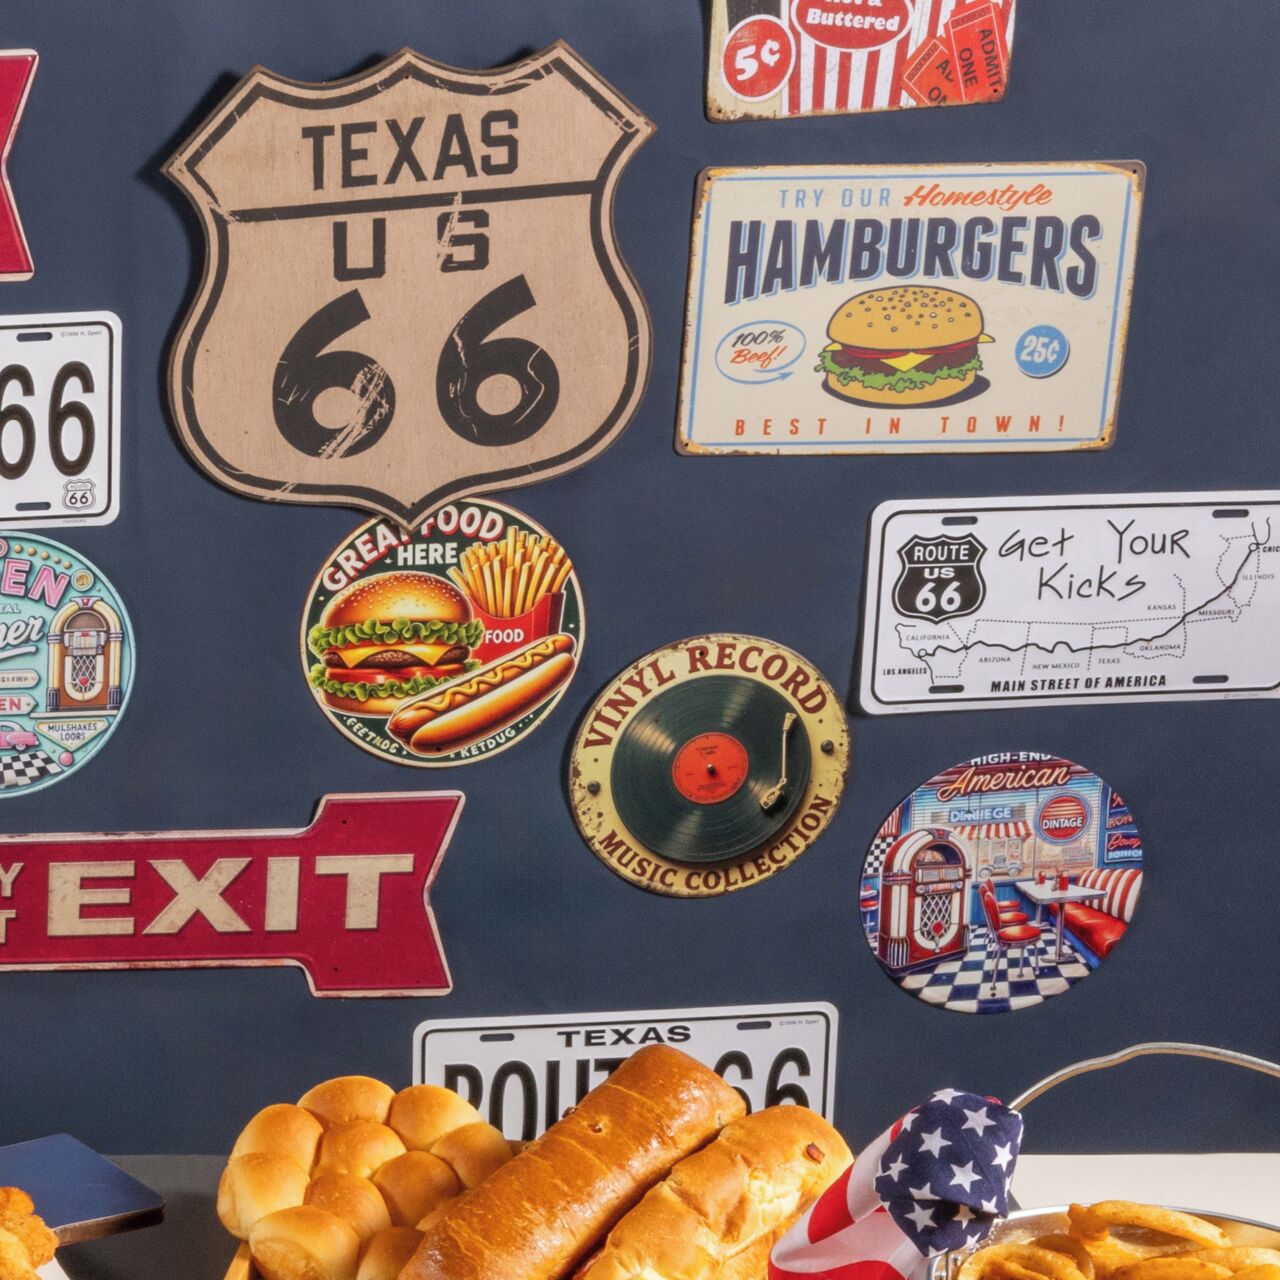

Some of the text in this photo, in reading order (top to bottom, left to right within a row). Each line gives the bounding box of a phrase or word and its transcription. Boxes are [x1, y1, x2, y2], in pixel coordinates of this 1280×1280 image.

[806, 8, 900, 31] Buttered
[733, 39, 782, 82] 5¢
[959, 47, 978, 88] ONE
[978, 28, 1003, 87] ADMIT
[301, 109, 519, 191] TEXAS
[779, 183, 1053, 211] TRY OUR Homestyle
[723, 214, 1104, 306] HAMBURGERS
[732, 330, 785, 347] 100%
[272, 273, 560, 460] 66
[730, 347, 784, 369] Beef!
[734, 415, 1066, 436] BEST IN TOWN!
[69, 492, 88, 505] 66
[397, 543, 458, 566] HERE
[914, 544, 971, 562] ROUTE
[999, 527, 1074, 562] Get
[924, 567, 955, 579] US
[915, 581, 962, 613] 66
[485, 629, 524, 644] FOOD
[906, 634, 951, 642] CALIFORNIA
[883, 667, 928, 676] LOS ANGELES
[1051, 662, 1080, 670] MEXICO
[990, 675, 1167, 693] MAIN STREET OF AMERICA
[584, 643, 827, 749] VINYL RECORD
[937, 766, 1070, 801] American
[599, 794, 834, 890] MUSIC COLLECTION
[47, 854, 414, 938] EXIT
[557, 1025, 691, 1048] TEXAS
